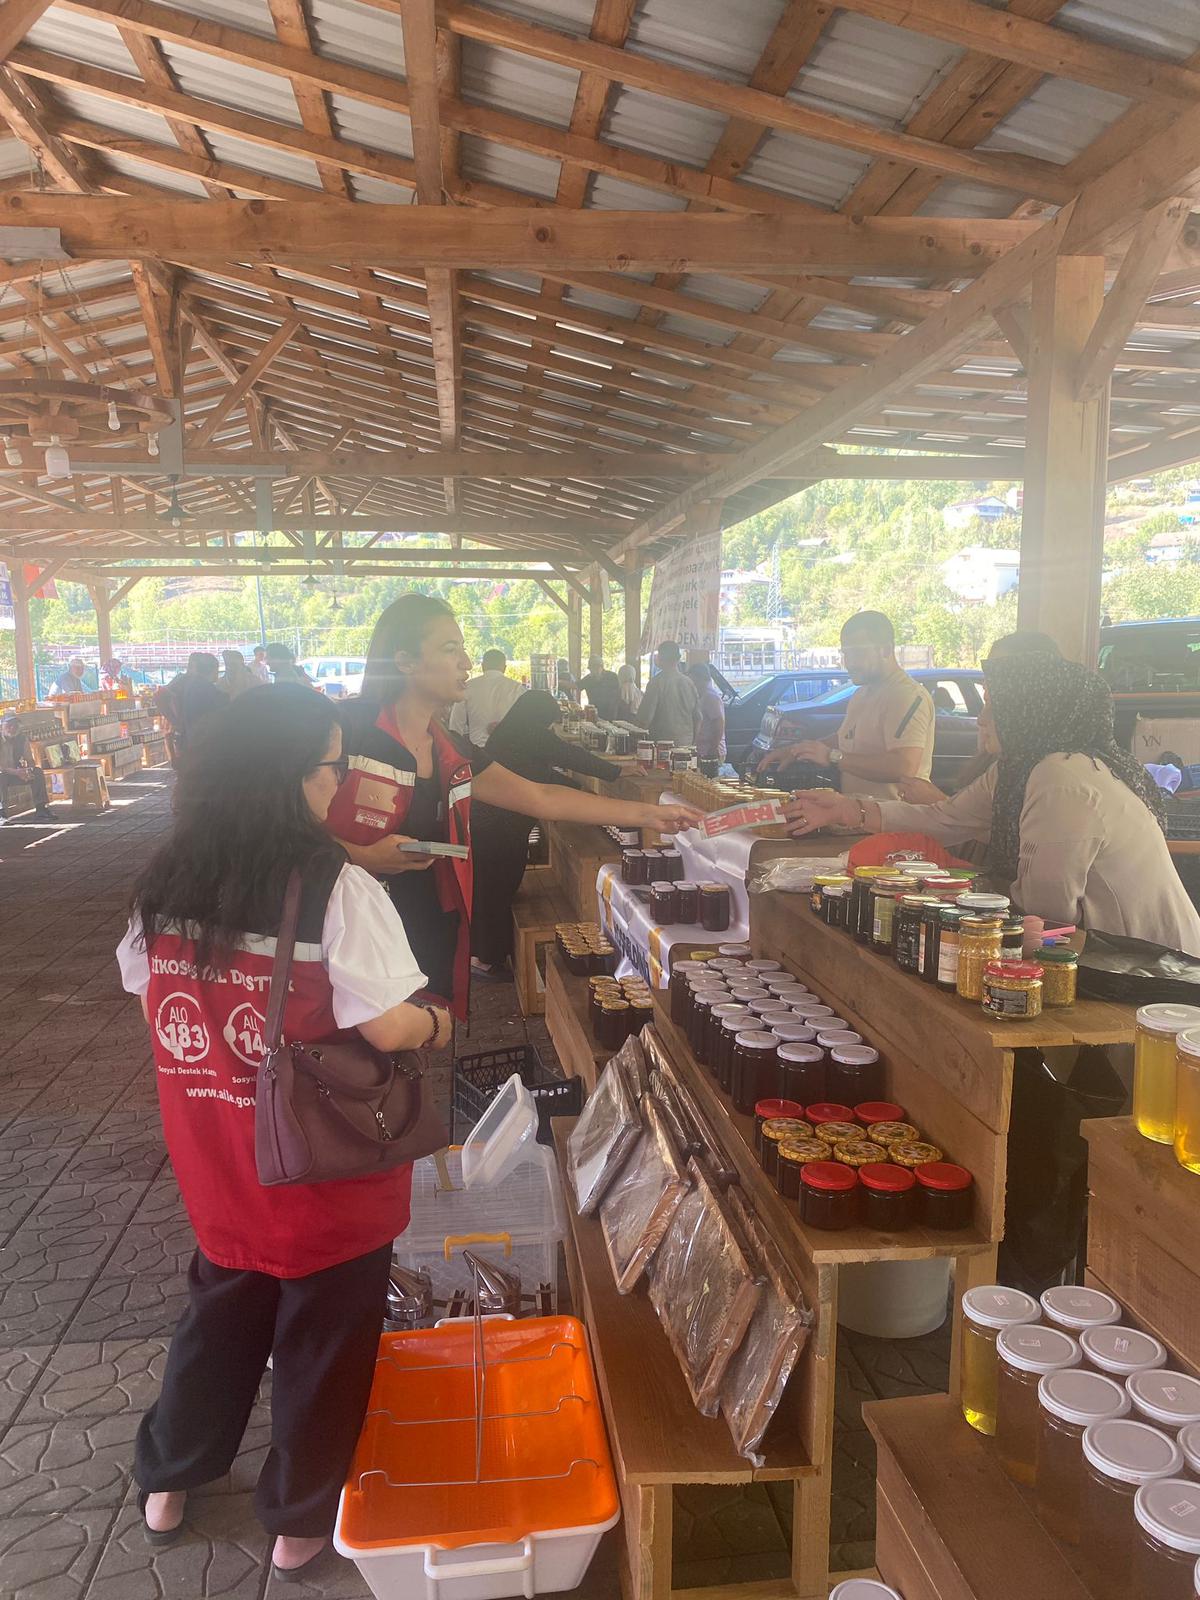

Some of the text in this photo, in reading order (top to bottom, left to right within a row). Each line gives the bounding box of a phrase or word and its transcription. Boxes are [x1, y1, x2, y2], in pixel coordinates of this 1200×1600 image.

[169, 1006, 188, 1024] ALO
[164, 1023, 205, 1050] 183
[238, 1030, 268, 1056] 14
[177, 1067, 201, 1076] Destek
